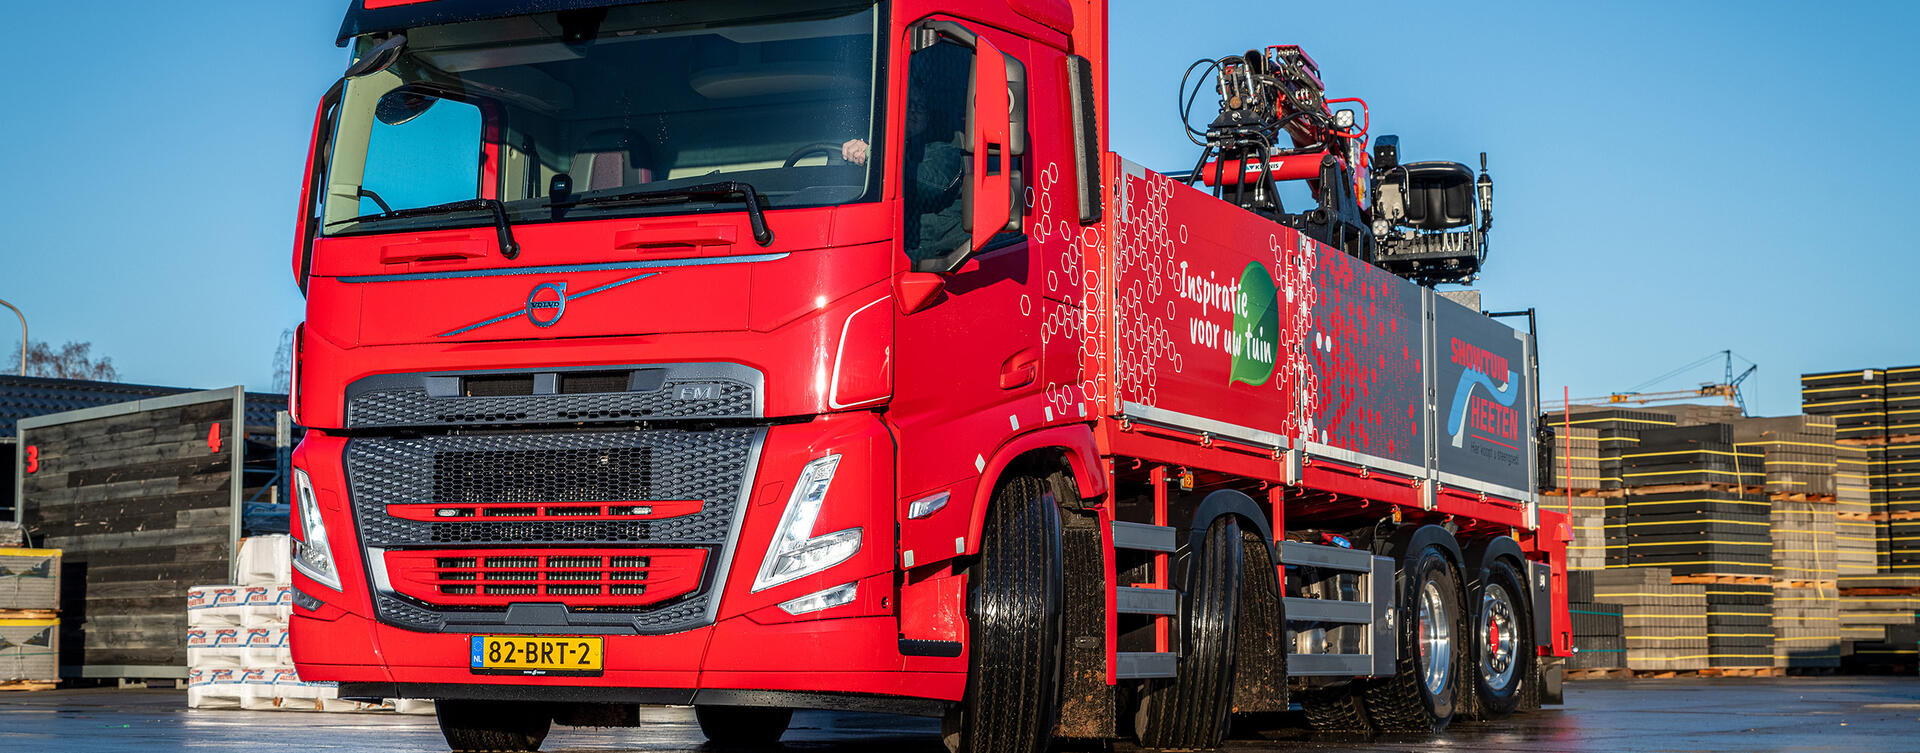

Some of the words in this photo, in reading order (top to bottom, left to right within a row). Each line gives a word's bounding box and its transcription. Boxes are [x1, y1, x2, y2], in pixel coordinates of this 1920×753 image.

[1180, 261, 1248, 318] Inspiratie
[1190, 317, 1220, 350] voor
[1223, 328, 1242, 357] uw
[1245, 323, 1272, 364] tuin
[1450, 337, 1509, 384] SHOWTUIN
[680, 387, 711, 401] FM
[1471, 395, 1518, 441] HEETEN
[207, 423, 222, 453] 4
[26, 445, 39, 473] 3
[473, 655, 482, 663] NL
[489, 641, 590, 664] 82-BRT-2
